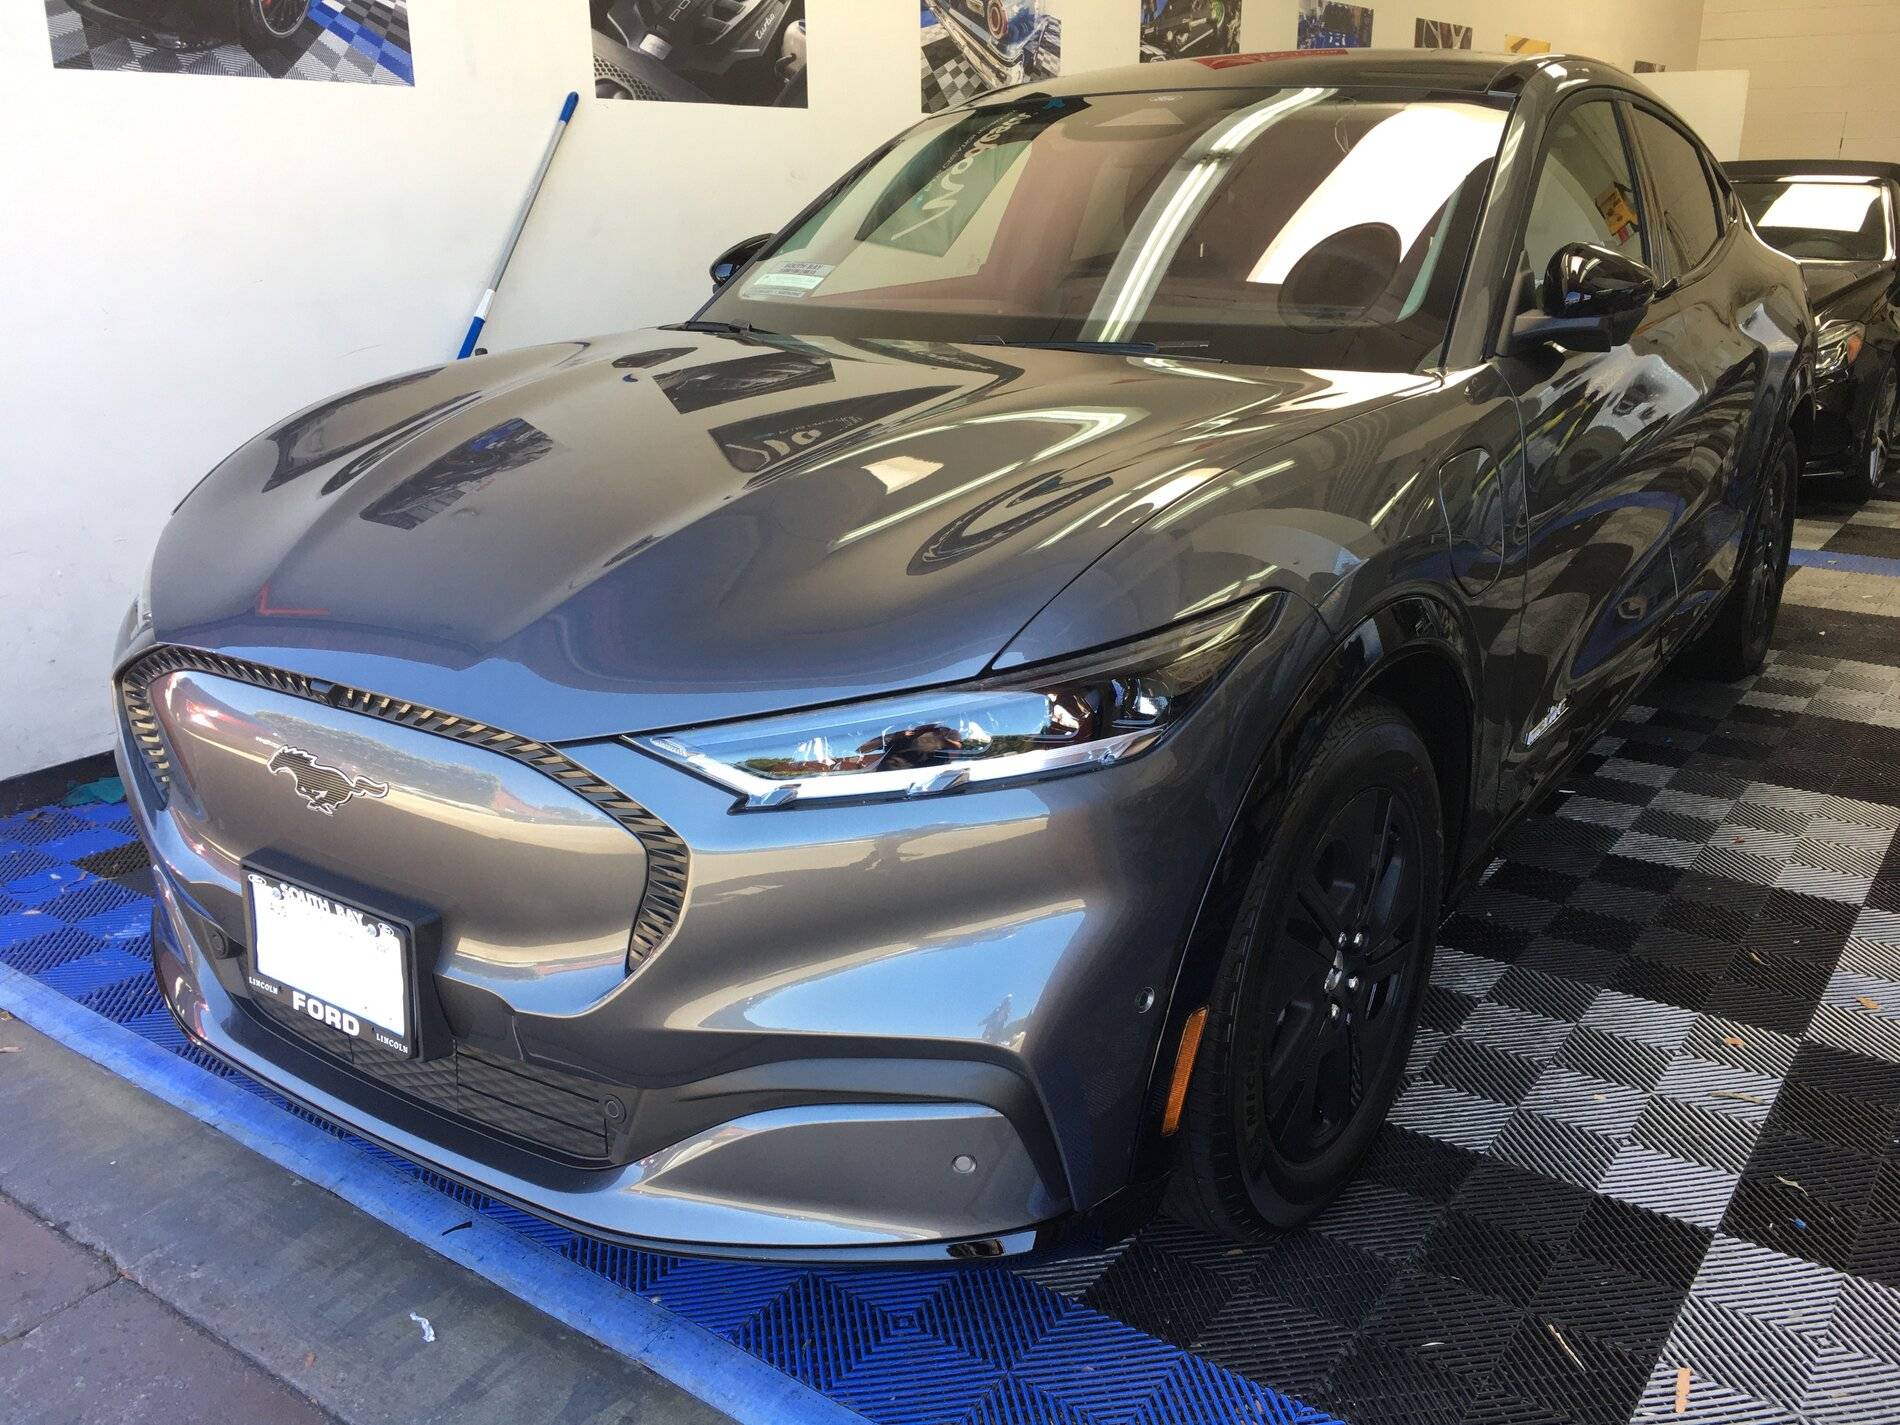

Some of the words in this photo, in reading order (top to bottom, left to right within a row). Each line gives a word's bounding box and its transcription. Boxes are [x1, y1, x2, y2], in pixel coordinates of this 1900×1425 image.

[280, 883, 331, 912] SOUTH
[334, 903, 364, 925] BAY
[249, 976, 278, 995] LINCOLN
[292, 990, 360, 1036] FORD
[376, 1033, 408, 1053] LINCOLN
